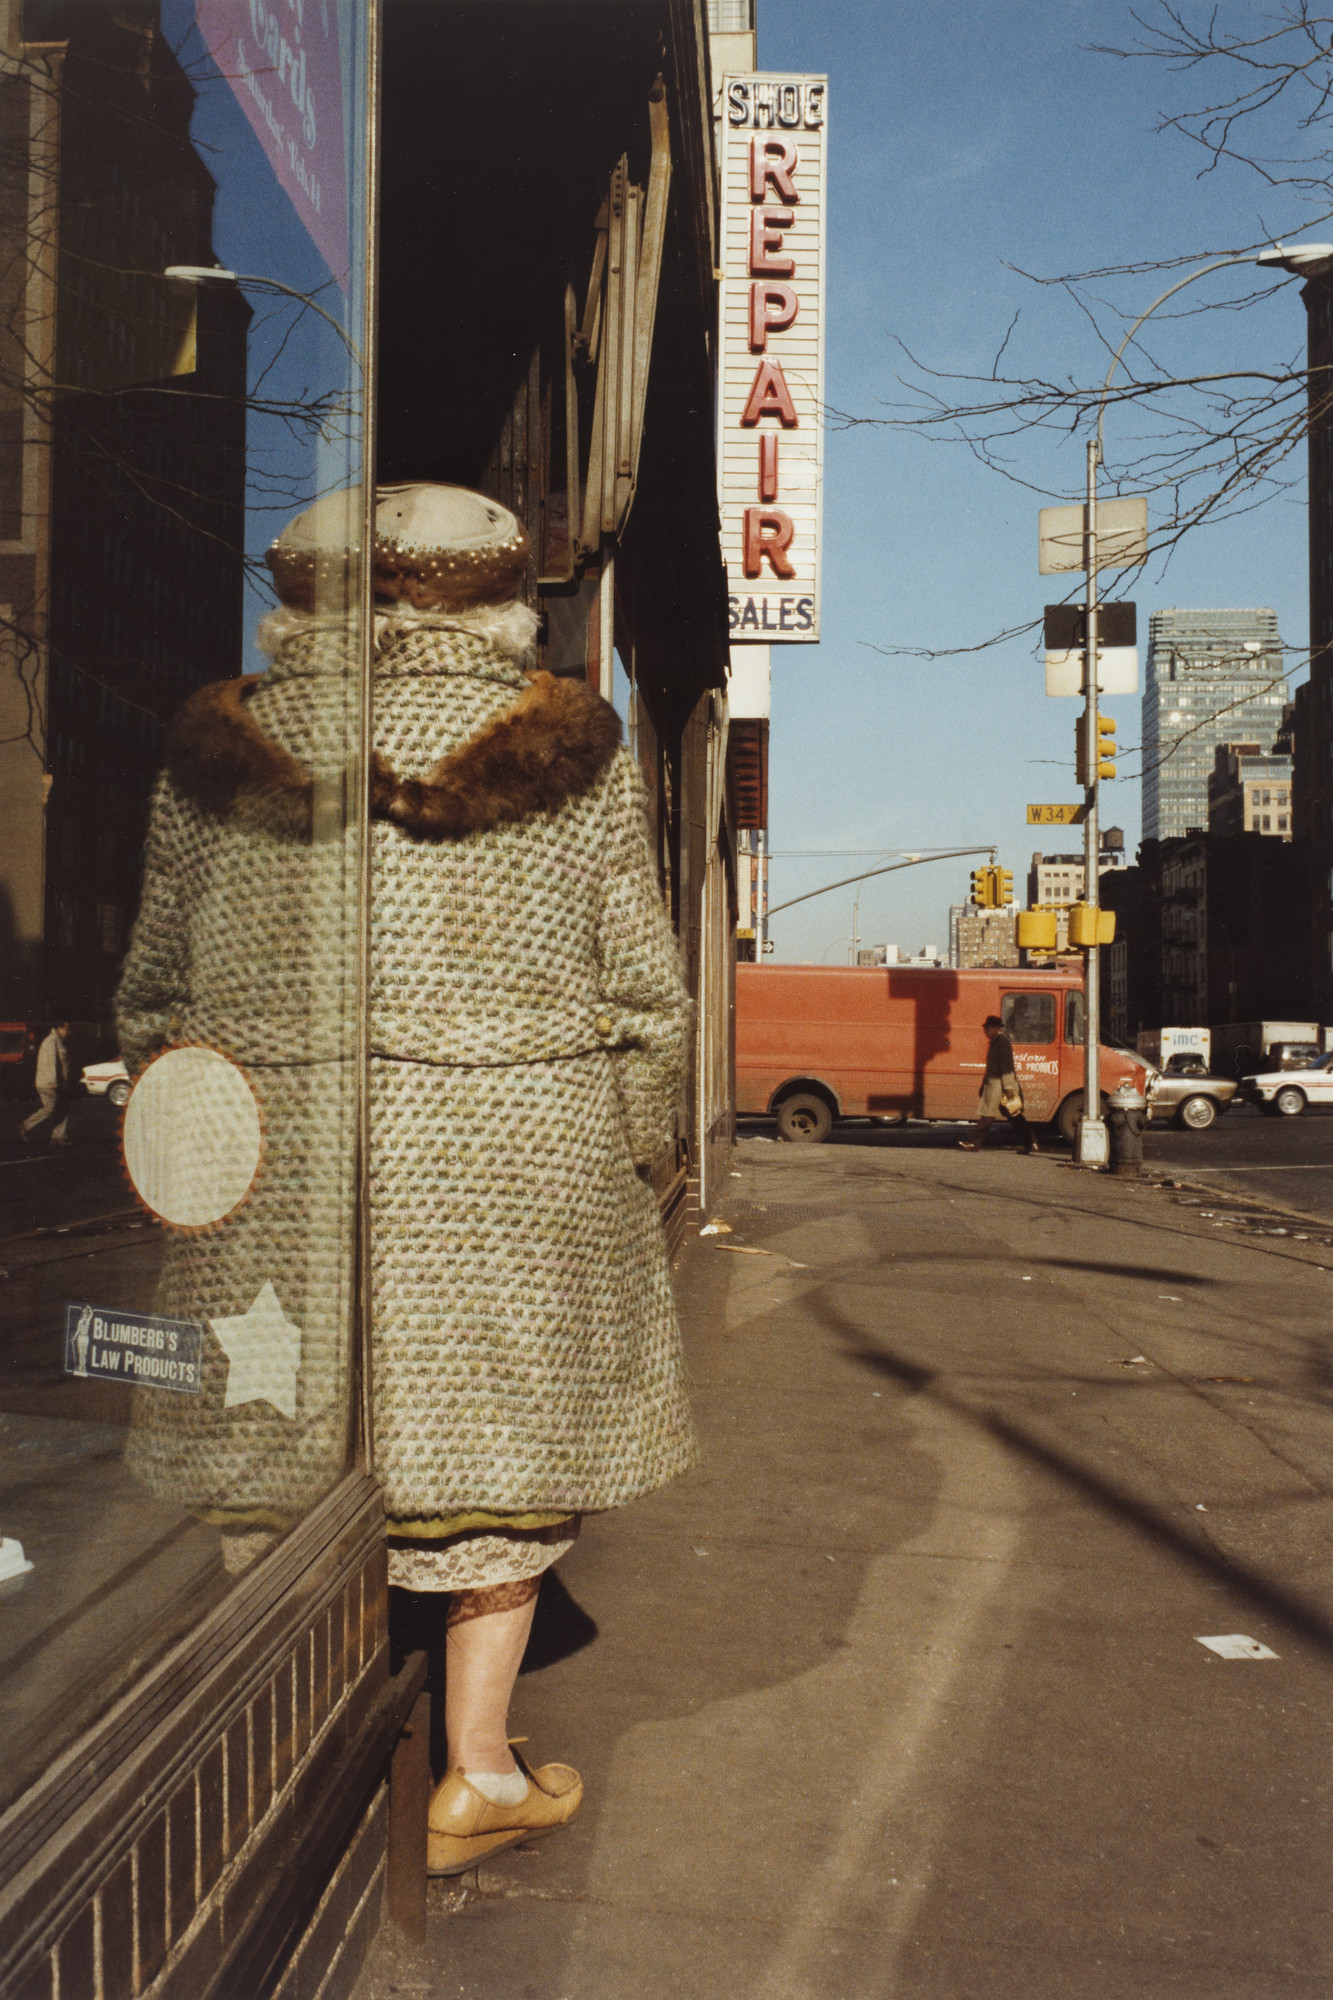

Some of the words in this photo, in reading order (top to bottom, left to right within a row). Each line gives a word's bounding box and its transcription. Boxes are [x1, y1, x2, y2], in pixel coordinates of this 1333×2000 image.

[727, 81, 824, 128] SHOE
[740, 132, 801, 580] REPAIR
[727, 596, 814, 631] SALES
[1032, 808, 1042, 821] W
[1045, 807, 1064, 822] 34
[94, 1318, 178, 1351] BLUMBERG'S
[92, 1346, 120, 1369] LAW
[125, 1351, 195, 1382] PRODUCTS
